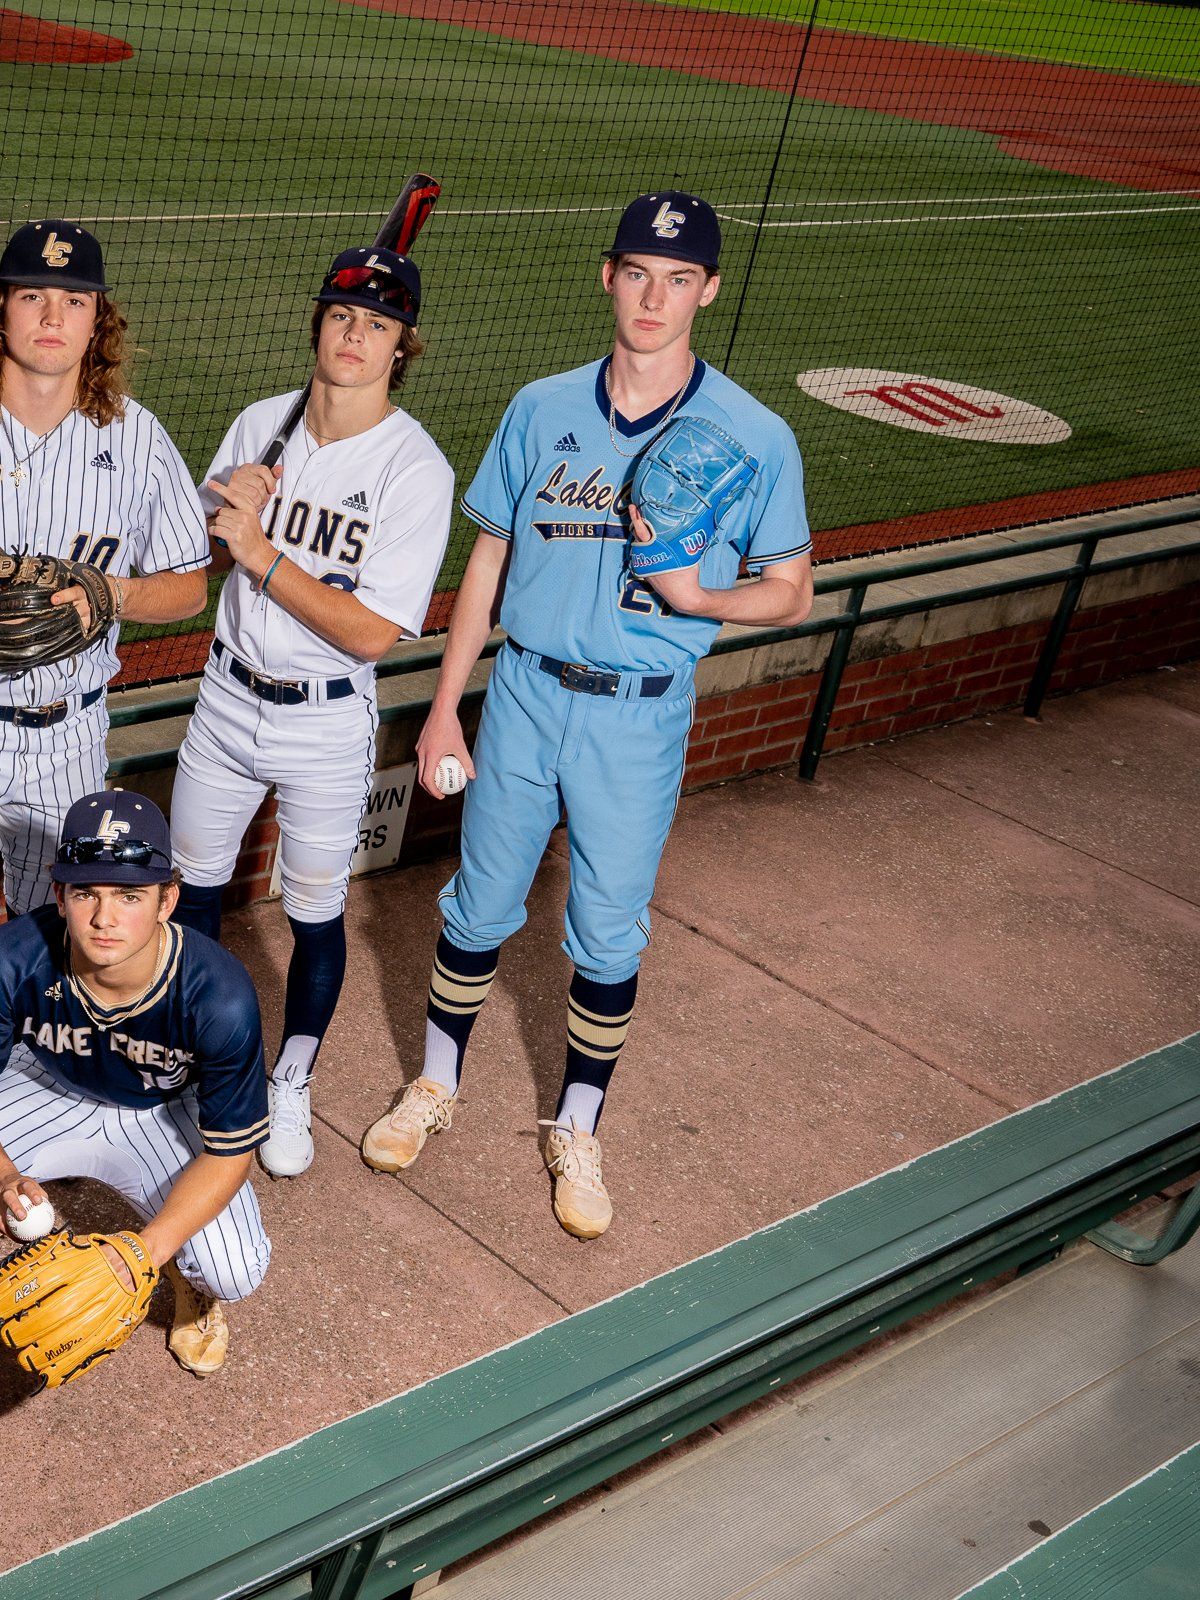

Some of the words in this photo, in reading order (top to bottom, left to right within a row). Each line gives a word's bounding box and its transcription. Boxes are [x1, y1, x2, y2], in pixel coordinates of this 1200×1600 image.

[650, 201, 686, 239] LC
[41, 232, 73, 267] LC
[553, 444, 581, 453] adidas
[90, 459, 118, 472] adidas
[536, 460, 616, 511] Lake
[342, 498, 369, 513] adidas
[266, 496, 371, 566] IONS
[552, 524, 594, 536] LIONS
[367, 784, 407, 816] WN
[354, 824, 388, 853] RS
[21, 1016, 93, 1057] LAKE
[14, 1277, 40, 1304] A2K
